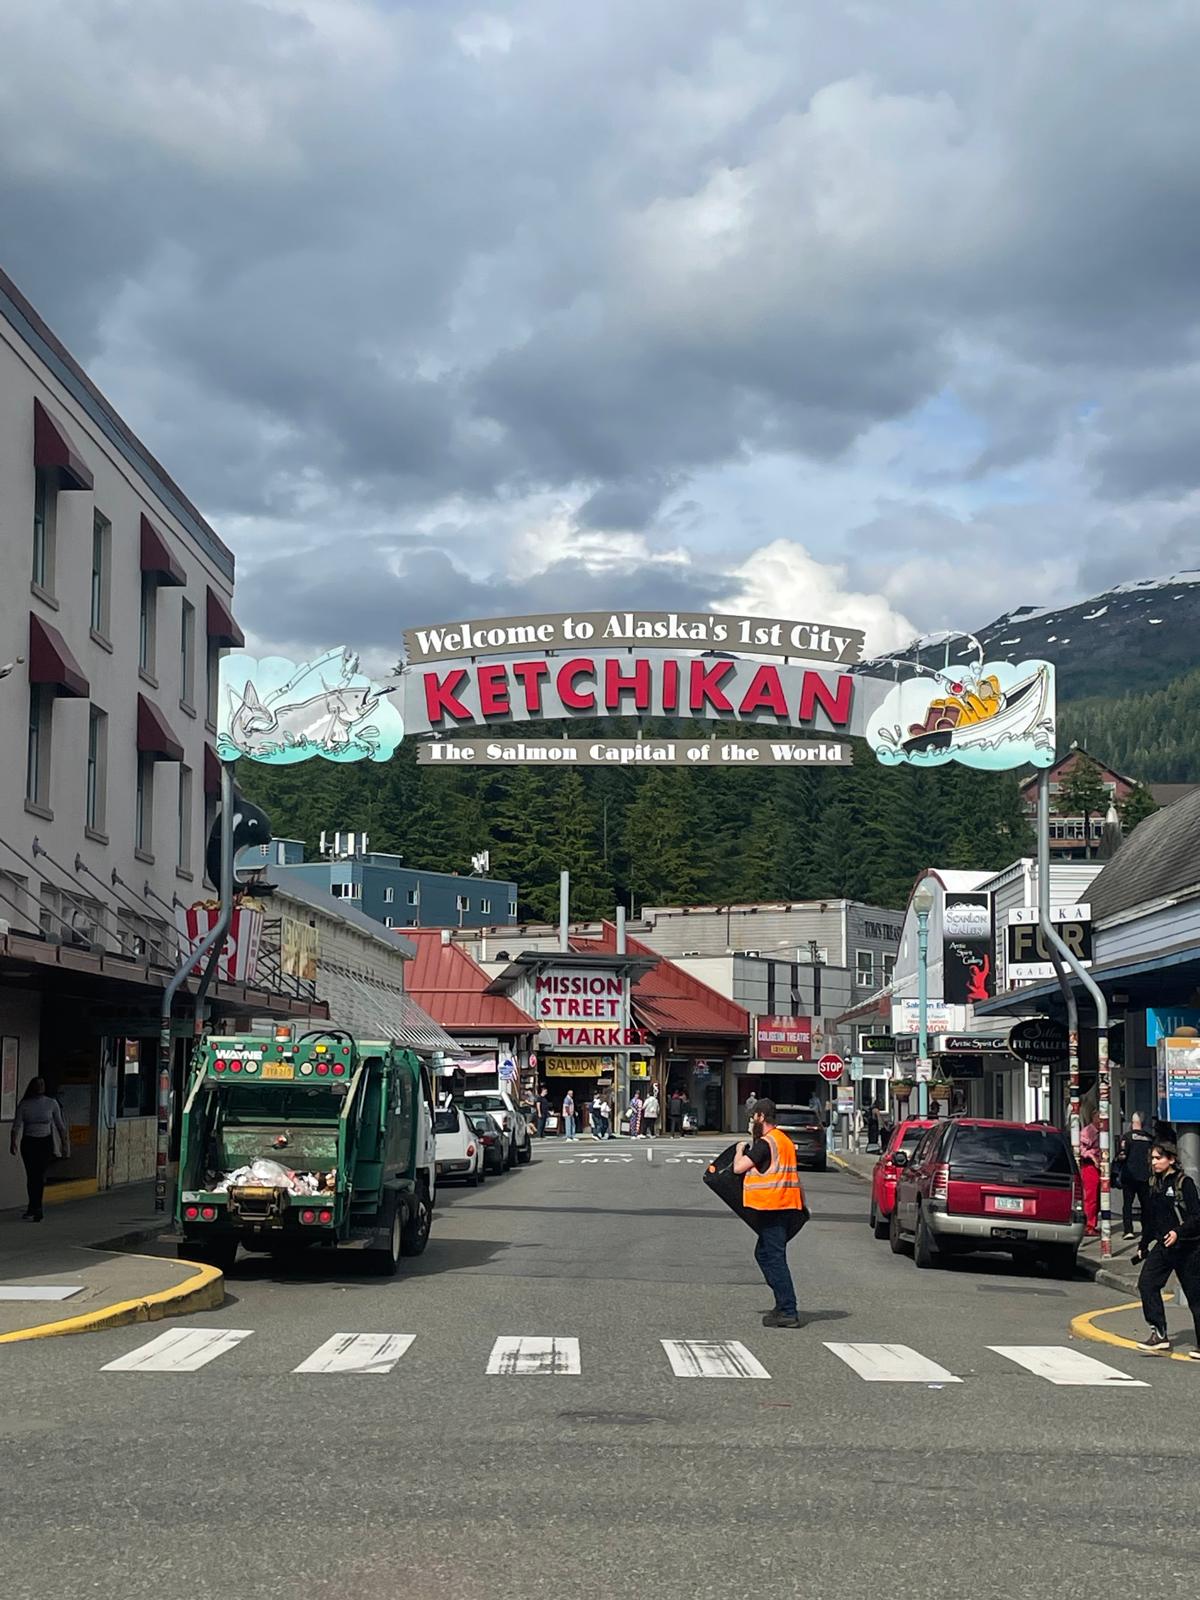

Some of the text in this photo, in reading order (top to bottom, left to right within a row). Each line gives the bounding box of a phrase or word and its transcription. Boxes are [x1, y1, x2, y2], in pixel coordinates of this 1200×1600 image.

[415, 613, 852, 662] Welcome to Alaska's 1st City
[424, 658, 854, 726] KETCHIKAN
[428, 743, 842, 764] The Salmon Capital of the World
[1016, 907, 1084, 922] SIKA
[1014, 922, 1086, 960] FUR
[536, 976, 623, 996] MISSION
[540, 997, 620, 1017] STREET
[905, 1001, 934, 1009] Salon
[557, 1027, 649, 1046] MARKET
[909, 1024, 948, 1033] SAMON
[1012, 1039, 1031, 1049] FUR
[216, 1049, 263, 1060] WAYNE
[548, 1058, 598, 1071] SALMON
[820, 1062, 843, 1073] STOP
